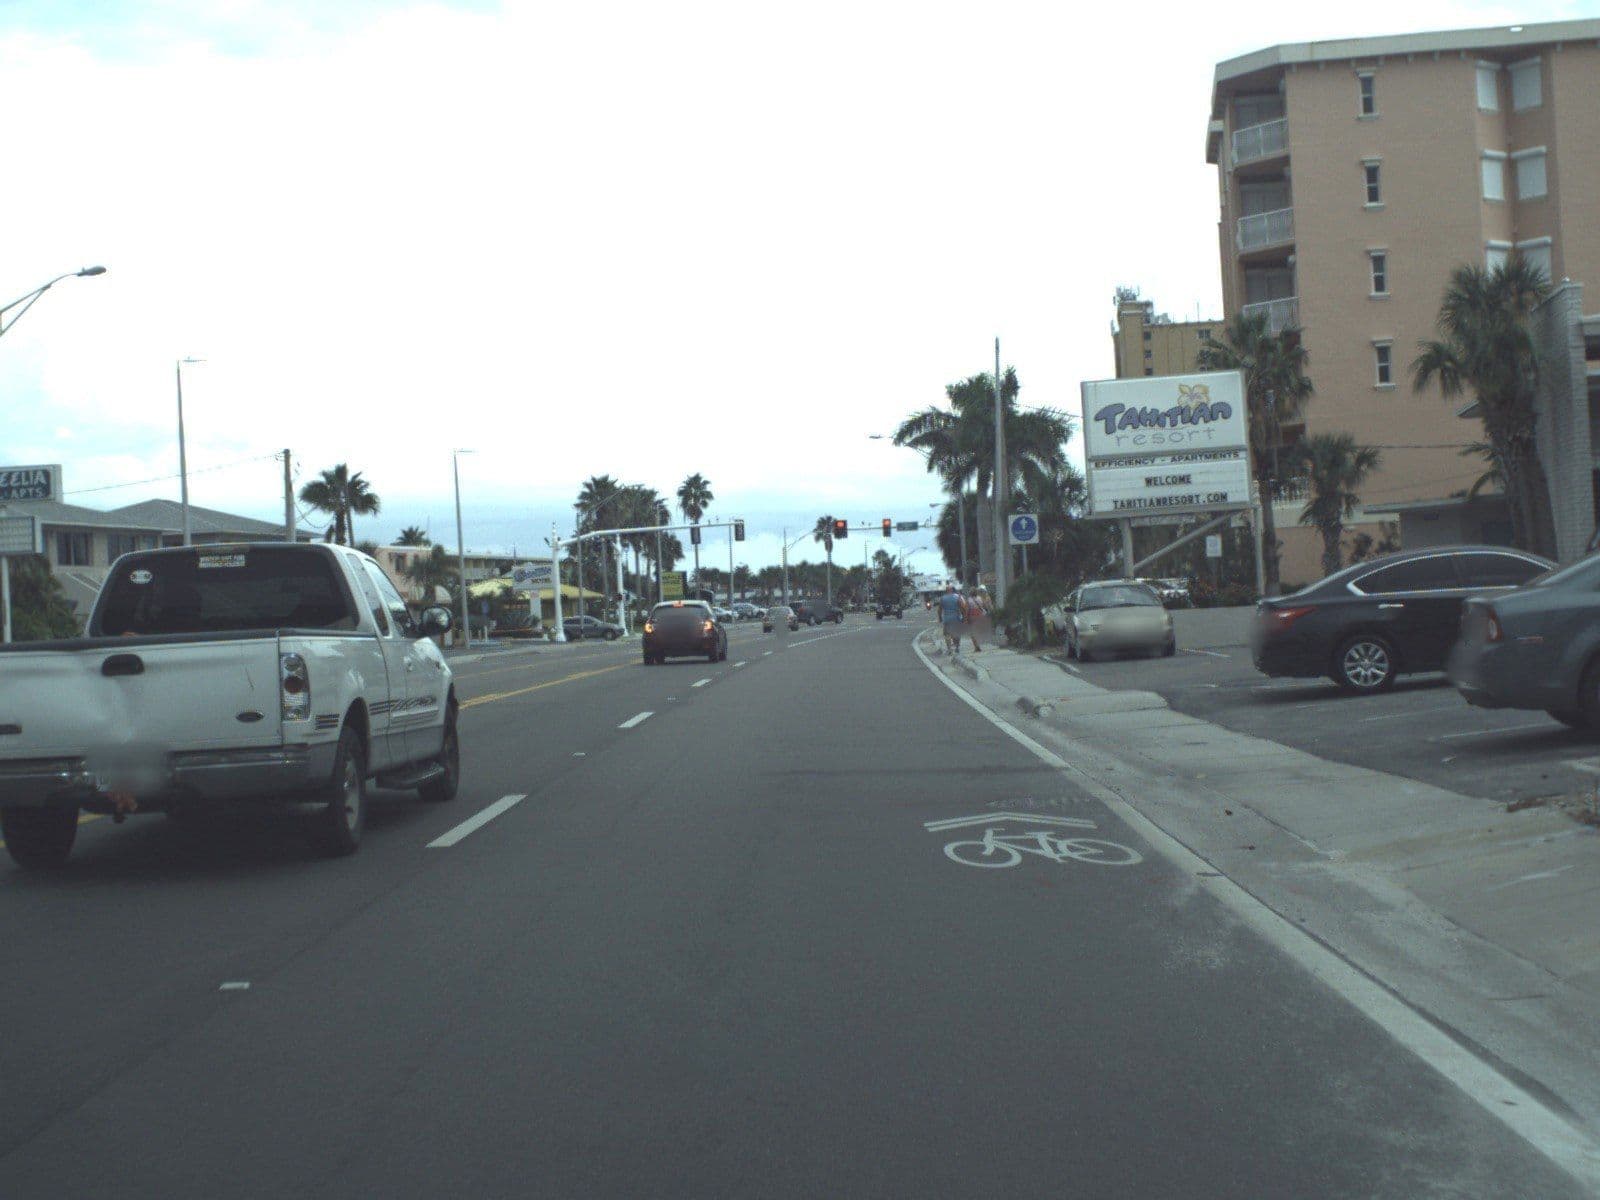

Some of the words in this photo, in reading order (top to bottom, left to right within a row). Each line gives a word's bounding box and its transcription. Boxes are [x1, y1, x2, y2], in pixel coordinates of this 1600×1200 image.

[1116, 427, 1215, 447] resort
[1095, 457, 1156, 469] EFFICIENCY
[1171, 451, 1240, 464] APARTMENTS
[1145, 474, 1192, 487] WELCOME
[1113, 492, 1228, 510] TAHITIANRESORT.COM
